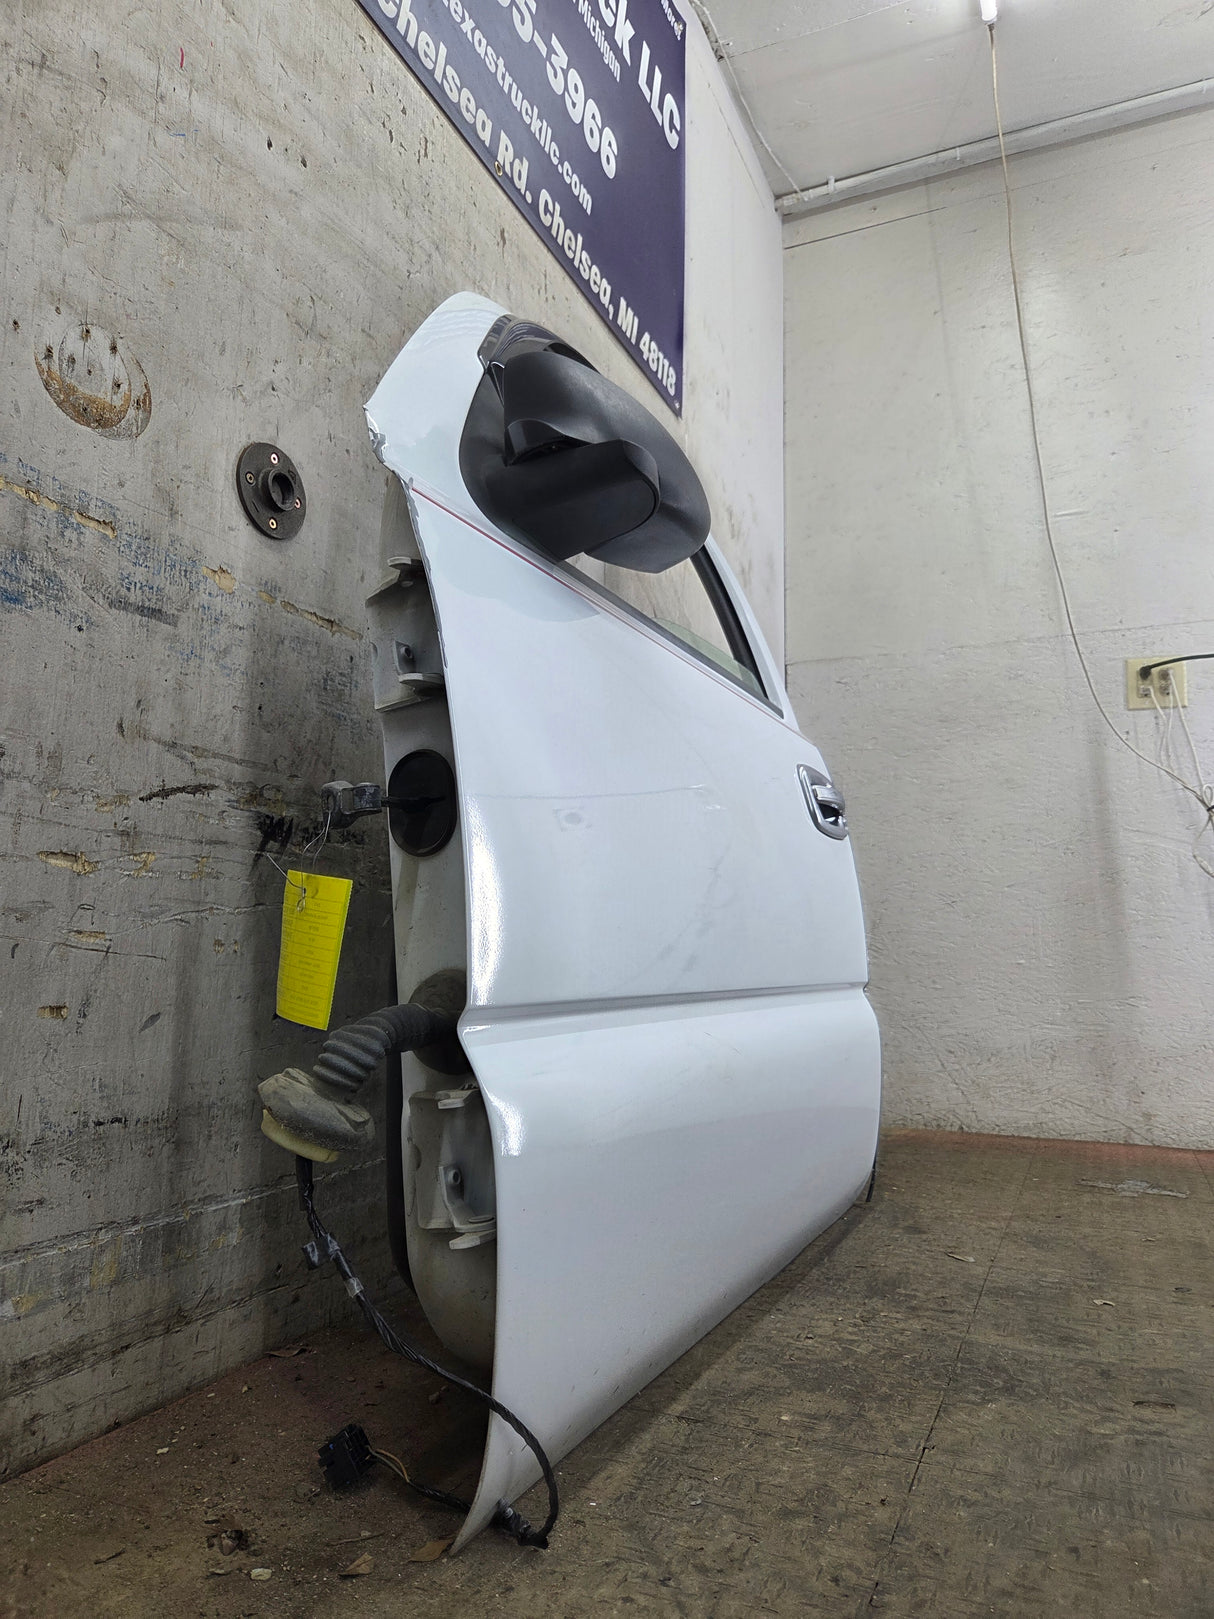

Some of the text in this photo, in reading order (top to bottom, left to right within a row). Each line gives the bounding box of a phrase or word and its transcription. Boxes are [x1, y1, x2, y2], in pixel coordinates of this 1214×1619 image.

[442, 0, 593, 216] exastruckllc.com
[496, 0, 619, 179] 5-3966
[577, 0, 621, 83] Michigan
[638, 40, 681, 150] LLC
[496, 129, 533, 204] Rd.
[538, 188, 614, 320] Chelsea,
[617, 296, 639, 345] MI
[639, 331, 677, 397] 48118
